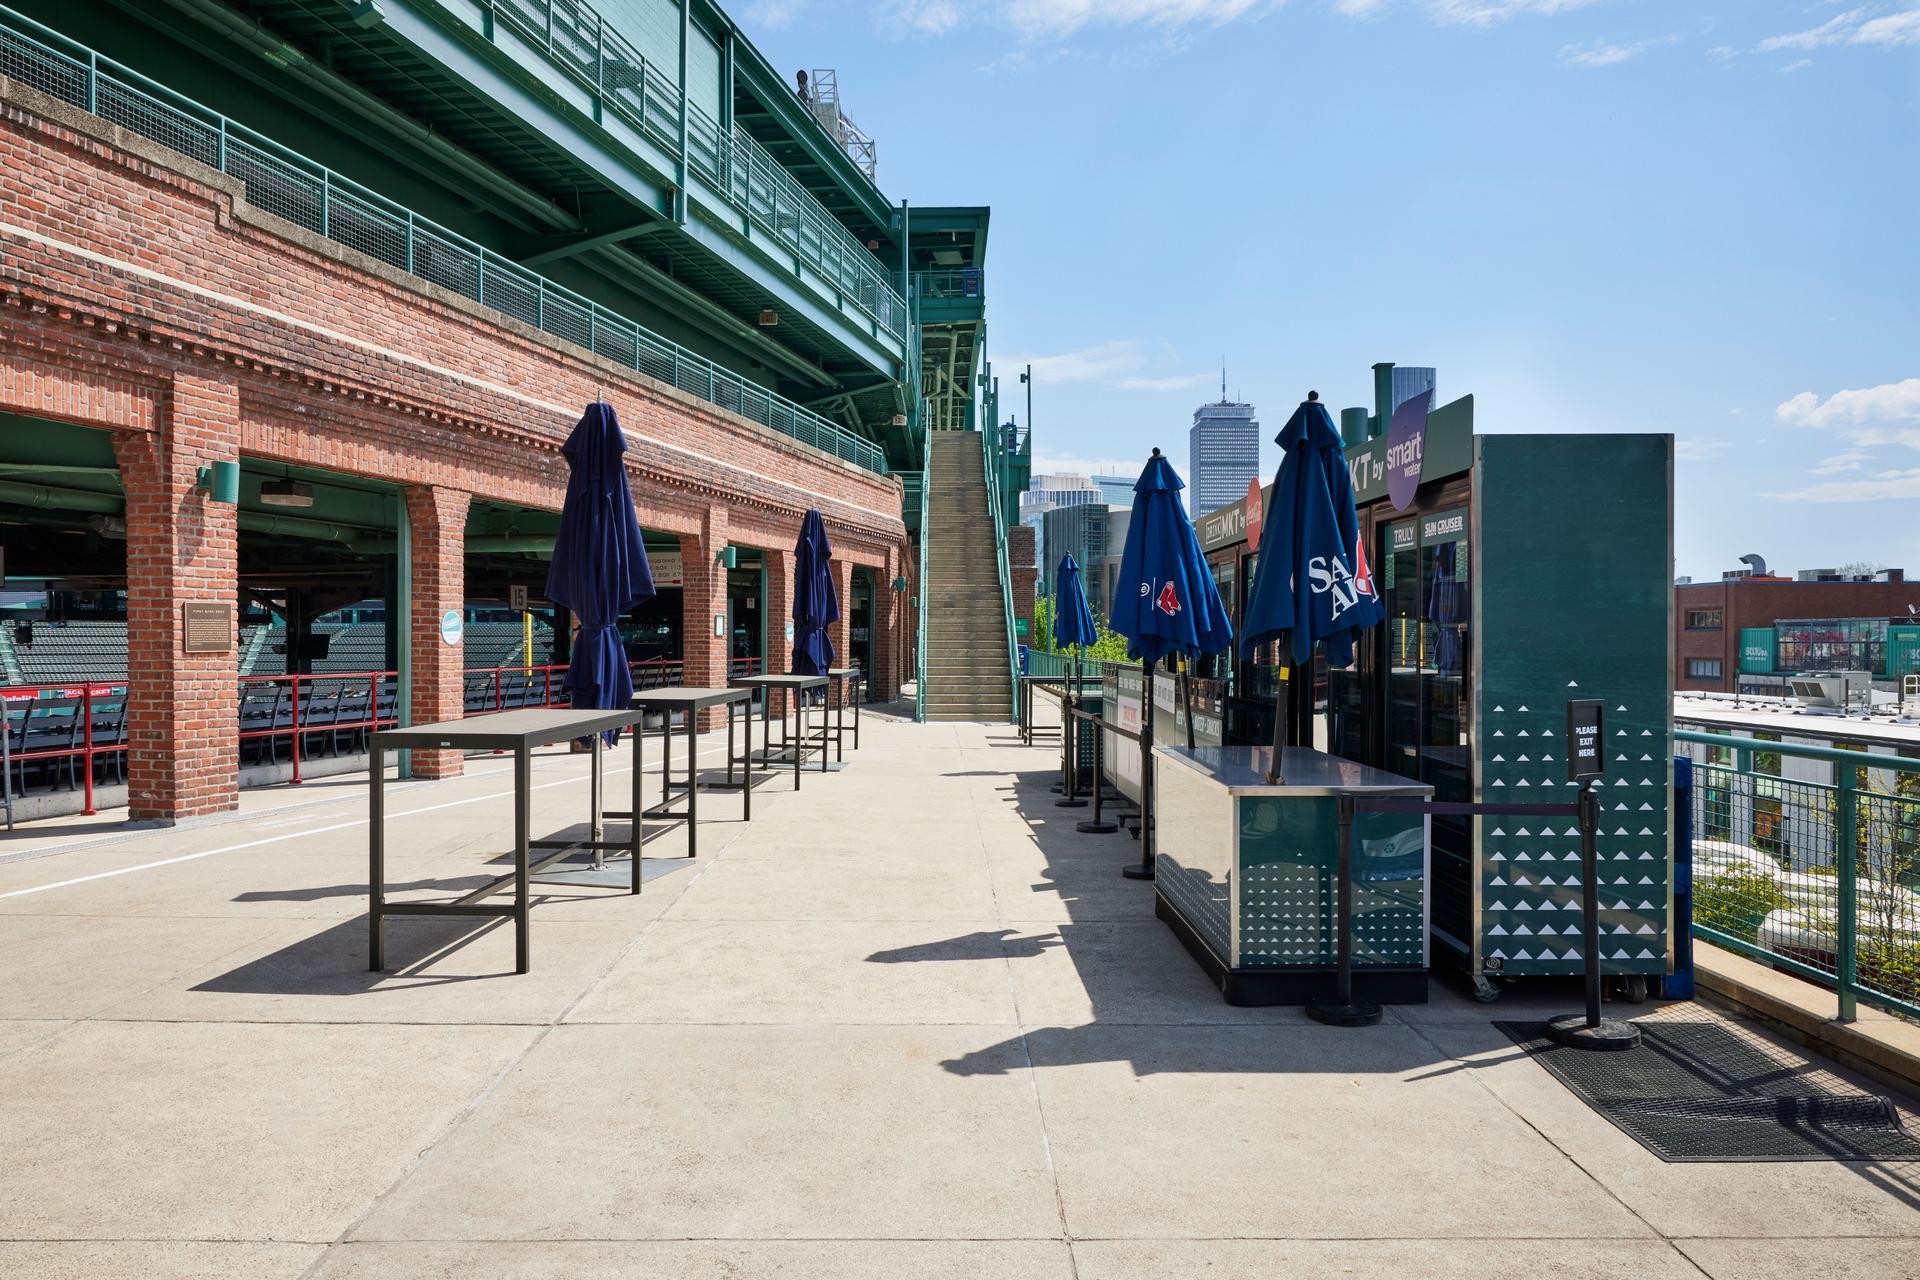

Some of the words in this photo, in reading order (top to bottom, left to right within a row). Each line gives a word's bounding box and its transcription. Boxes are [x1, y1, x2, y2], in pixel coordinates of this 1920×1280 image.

[1387, 432, 1422, 470] smart
[1373, 460, 1384, 480] by
[1404, 463, 1421, 478] water
[1222, 508, 1240, 539] MKT
[1424, 521, 1437, 538] SUN
[1437, 515, 1463, 535] CRUISER
[1394, 526, 1414, 543] TRULY
[514, 588, 524, 606] 15
[90, 688, 112, 696] CKET
[1575, 726, 1598, 735] PLEASE
[1579, 737, 1594, 746] EXIT
[1578, 748, 1596, 758] HERE
